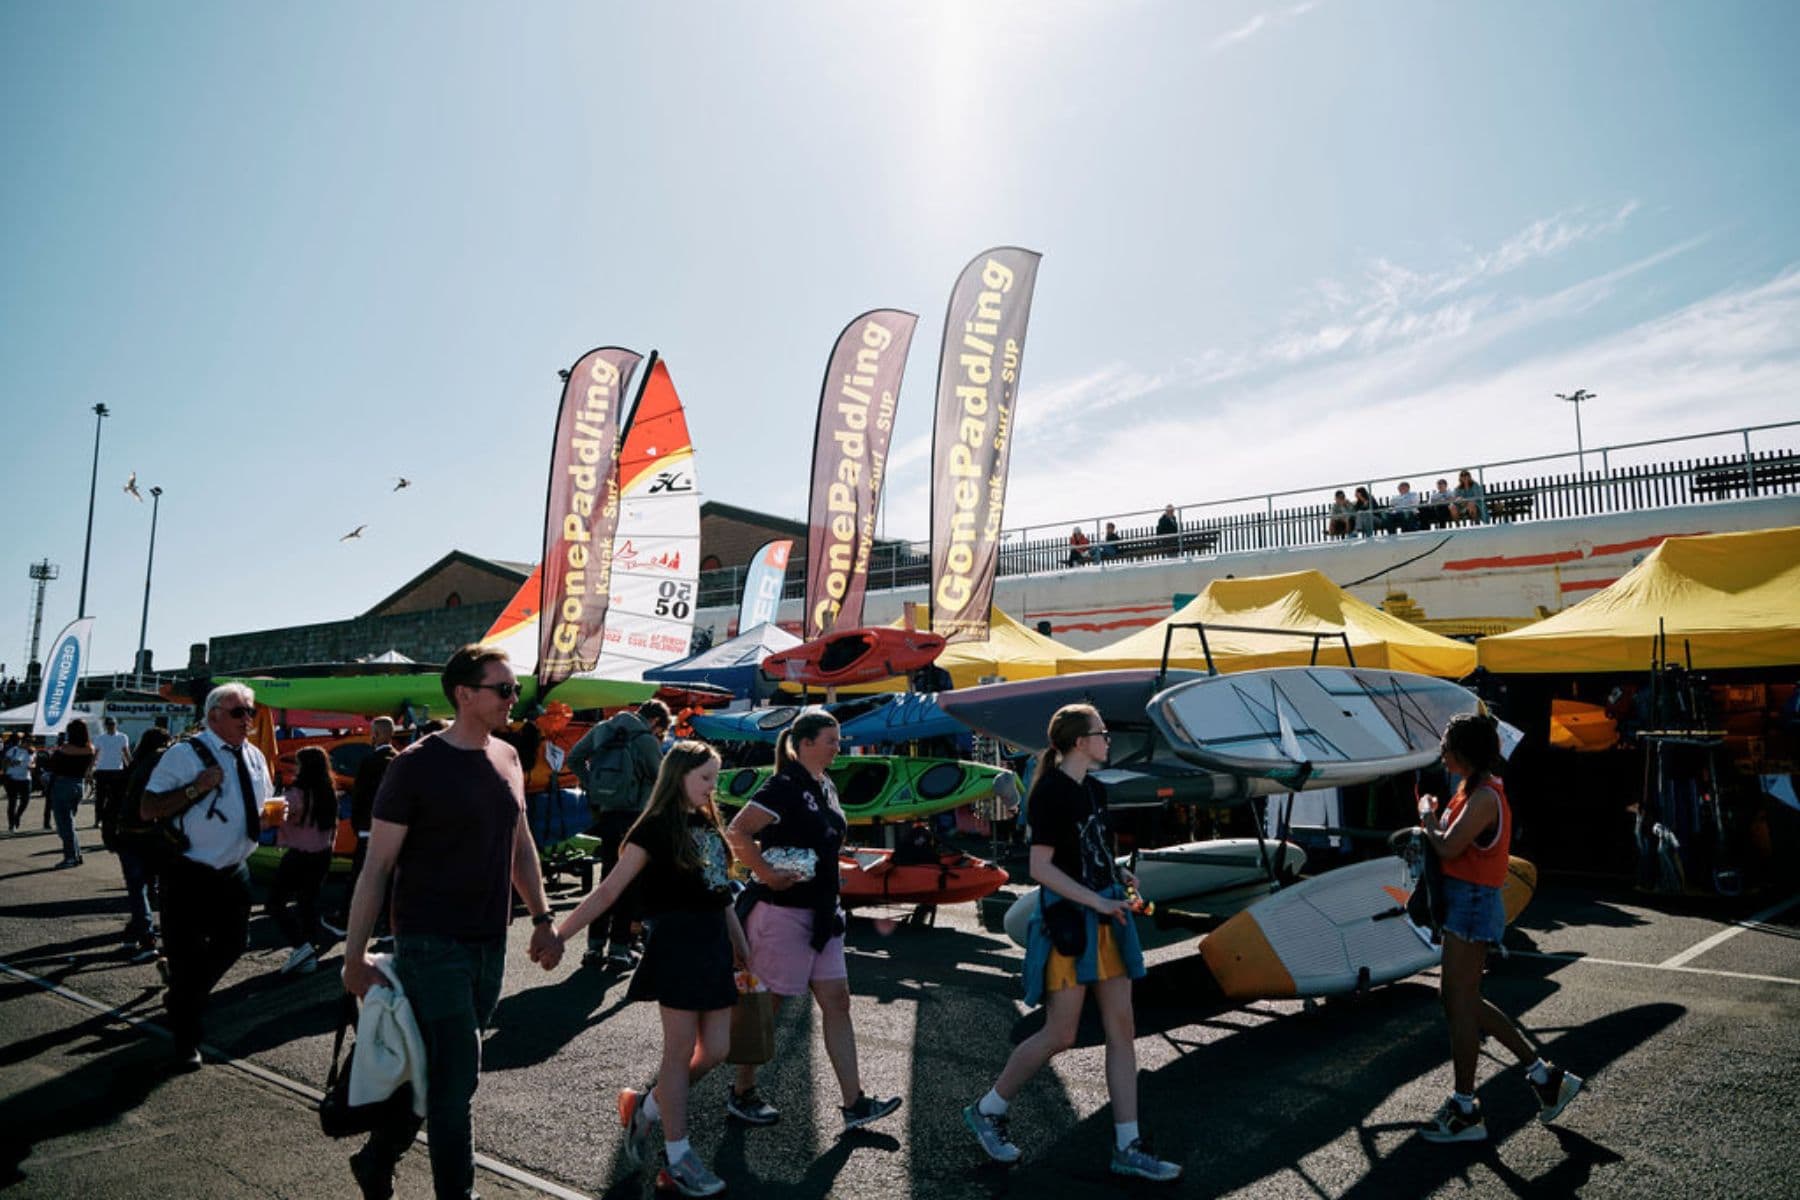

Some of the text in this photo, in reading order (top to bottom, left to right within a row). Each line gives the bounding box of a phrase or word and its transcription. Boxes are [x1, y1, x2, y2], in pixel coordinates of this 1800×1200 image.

[876, 390, 896, 432] SUP
[936, 258, 1014, 612] GonePaddling
[983, 338, 1020, 542] Kayak Surf SUP
[603, 478, 620, 520] Surf
[869, 450, 884, 492] Surf
[553, 357, 620, 653] GonePaddling
[655, 598, 690, 619] 50
[48, 645, 76, 719] GEOMARINE
